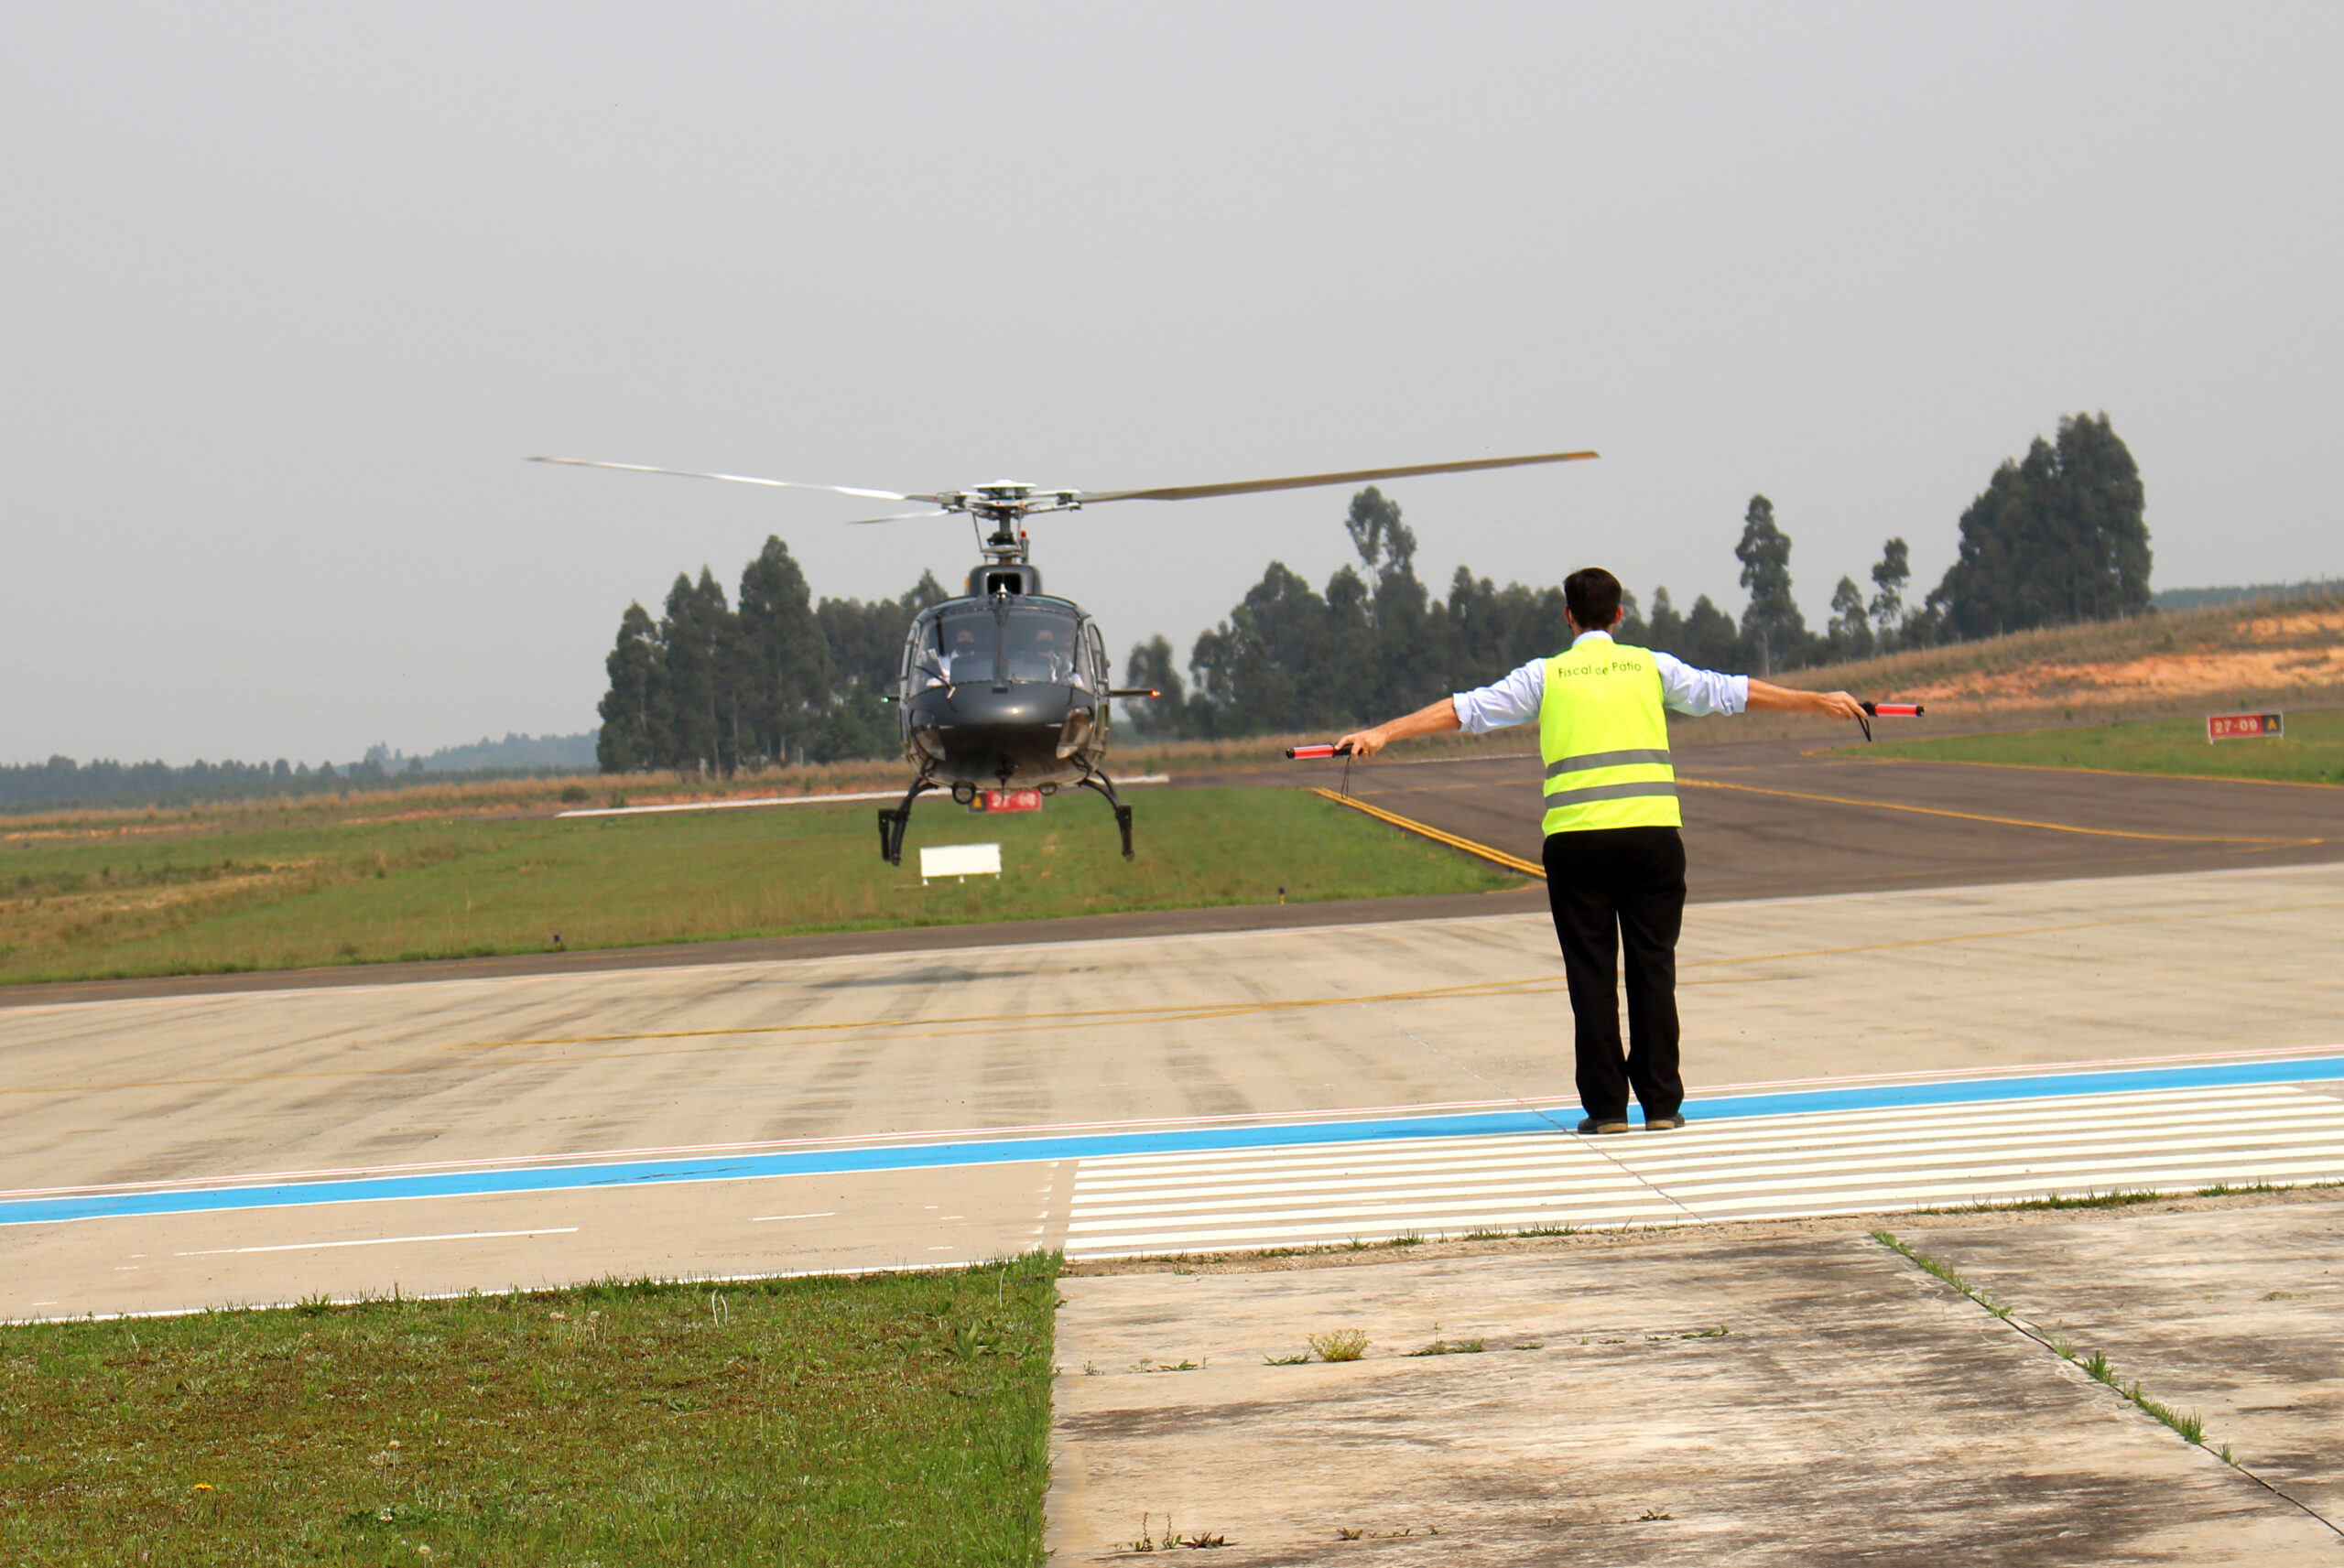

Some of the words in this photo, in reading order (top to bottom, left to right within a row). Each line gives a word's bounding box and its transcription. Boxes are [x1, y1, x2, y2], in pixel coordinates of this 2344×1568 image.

[1558, 665, 1591, 678] Fiscal
[1595, 666, 1609, 676] de
[1612, 660, 1642, 672] Pátio
[2214, 718, 2258, 734] 27-09
[2267, 718, 2278, 730] A
